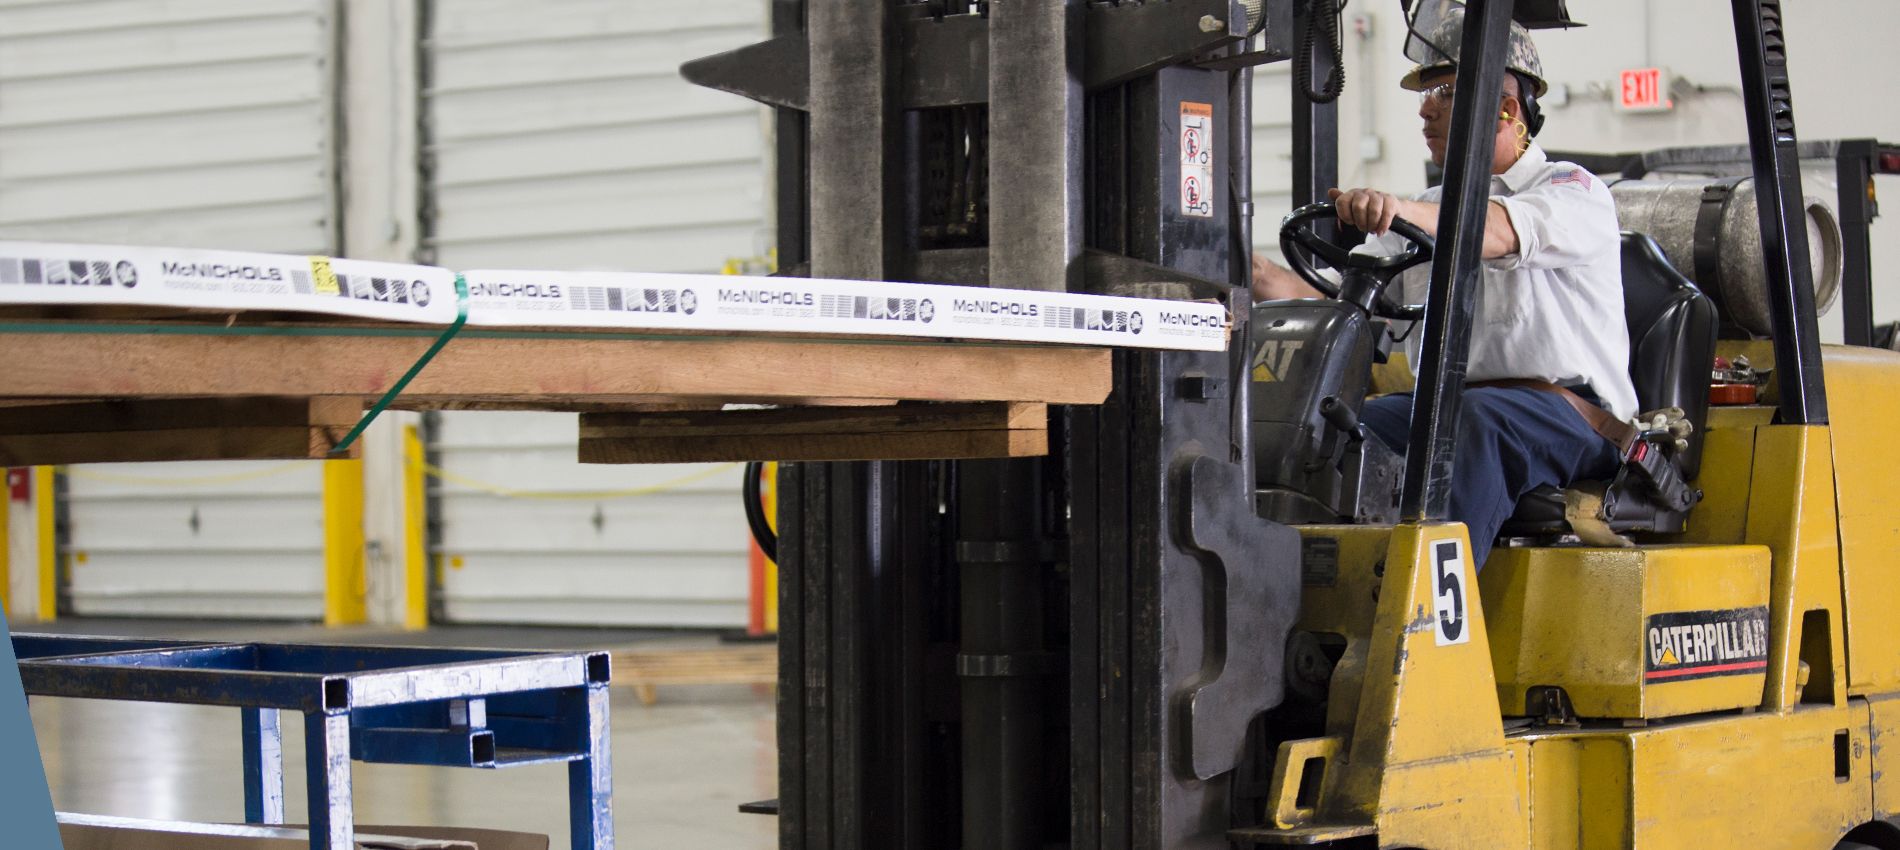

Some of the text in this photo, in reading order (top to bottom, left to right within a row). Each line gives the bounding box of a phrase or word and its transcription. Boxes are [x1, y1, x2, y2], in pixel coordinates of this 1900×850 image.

[1621, 69, 1660, 107] EXIT
[162, 261, 283, 281] McNICHOLS
[455, 281, 563, 298] cNICHOLS
[718, 289, 814, 306] McNICHOLS
[953, 299, 1038, 317] McNICHOLS
[1252, 340, 1305, 382] AT
[1436, 542, 1463, 641] 5
[1649, 619, 1767, 666] CATERPILLAR
